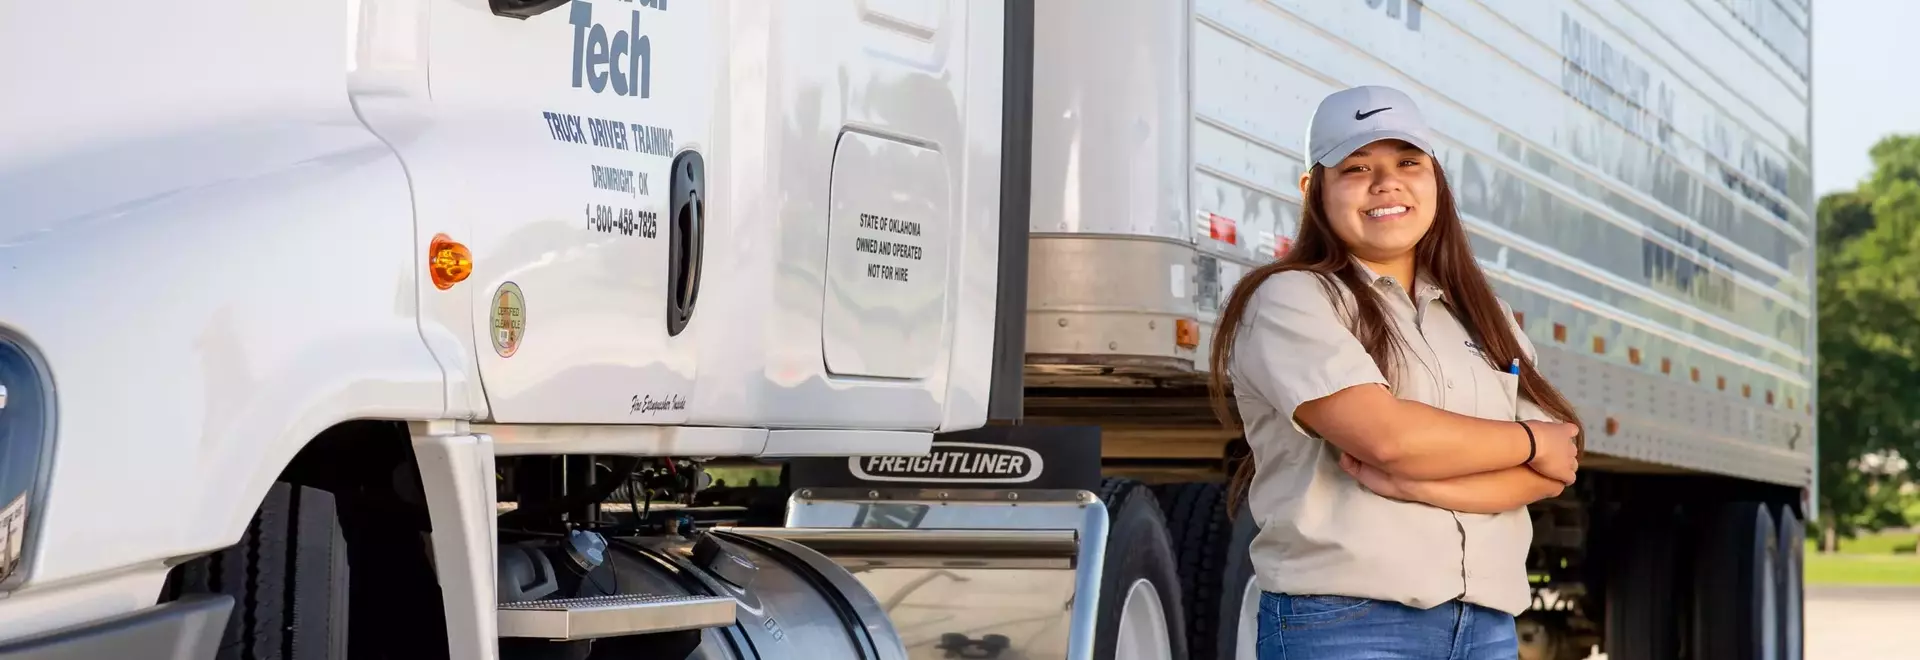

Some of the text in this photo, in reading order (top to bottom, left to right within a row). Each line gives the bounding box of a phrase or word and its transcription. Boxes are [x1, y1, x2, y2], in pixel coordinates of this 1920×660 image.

[569, 1, 651, 99] Tech
[543, 111, 674, 158] TRUCK DRIVER TRAINING
[591, 164, 649, 199] DRUMRIGHT, OK
[585, 203, 657, 239] 1-800-458-7825
[860, 213, 921, 236] STATE OF OKLAHOMA
[856, 237, 922, 260] OWNED AND OPERATED
[867, 263, 908, 282] NOT FOR HIRE
[497, 306, 520, 317] CERTIFIED
[866, 452, 1024, 474] FREIGHTLINER
